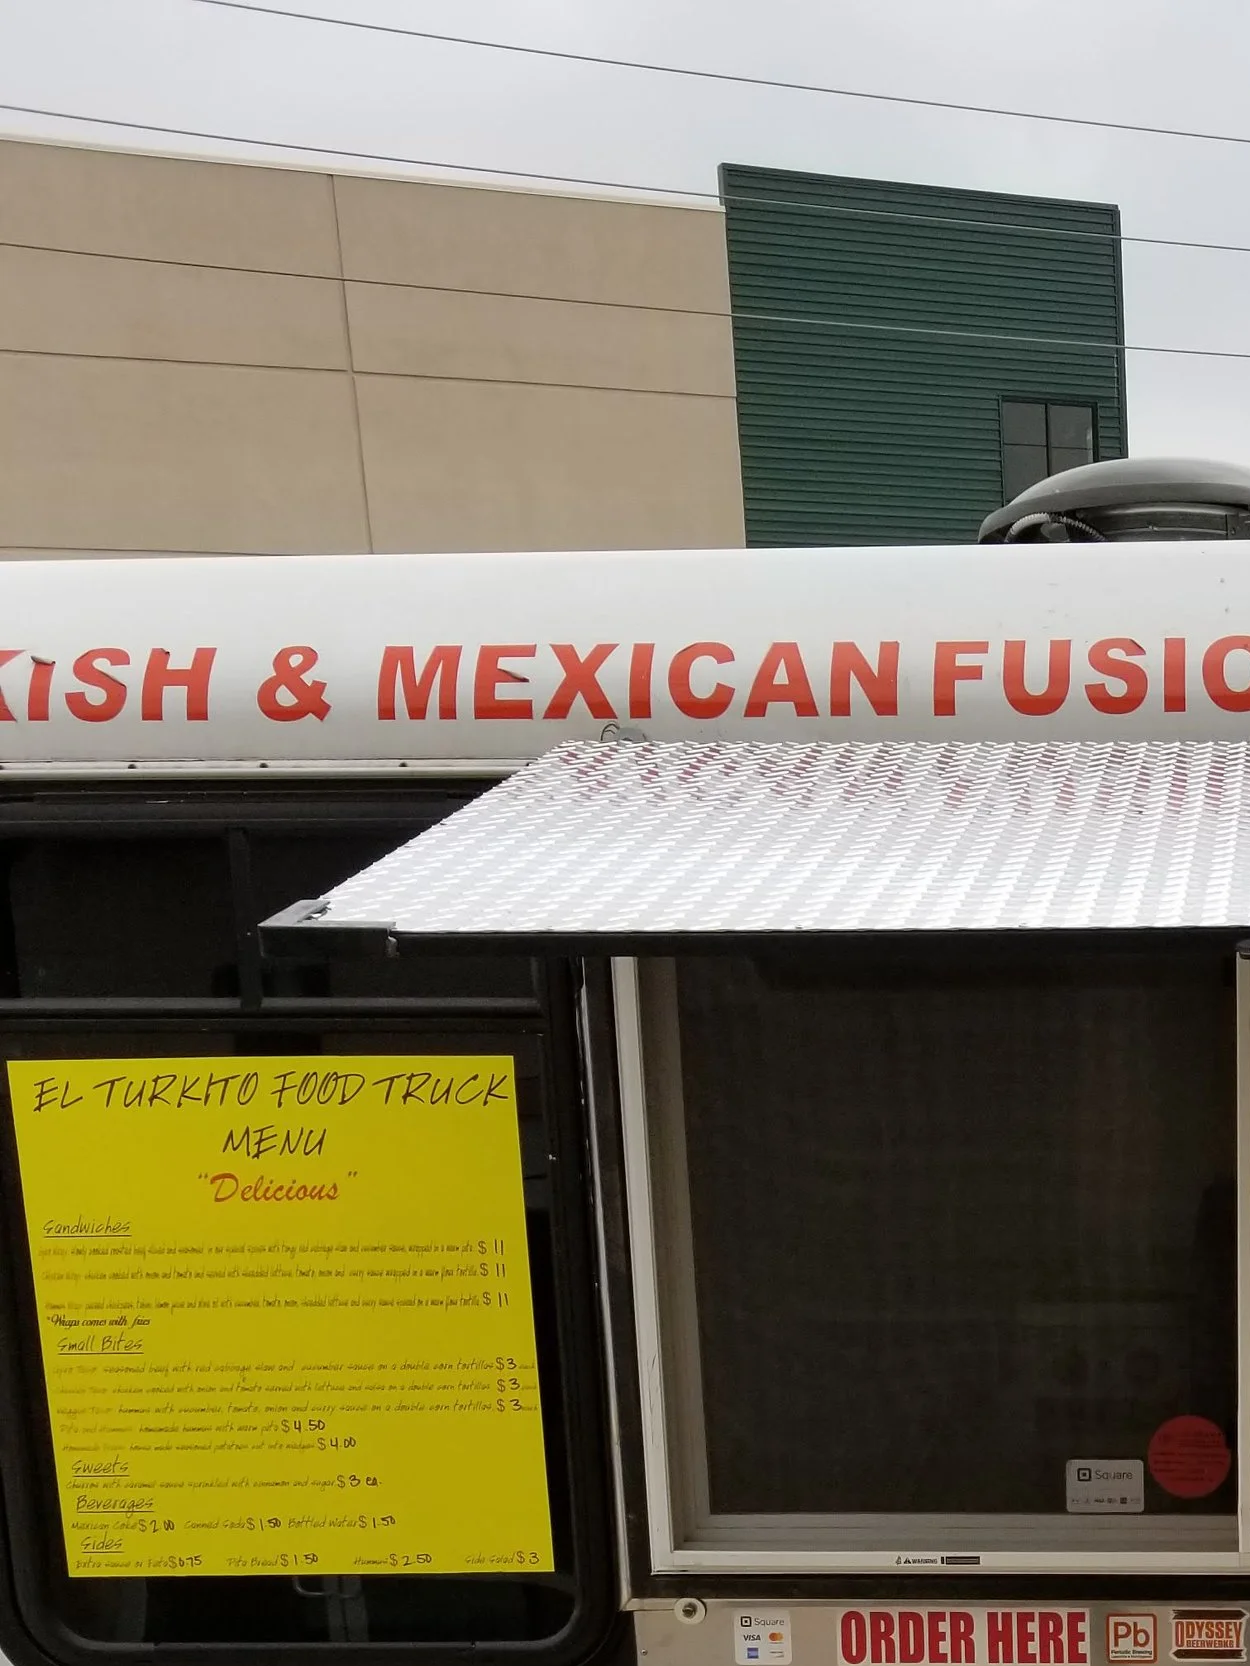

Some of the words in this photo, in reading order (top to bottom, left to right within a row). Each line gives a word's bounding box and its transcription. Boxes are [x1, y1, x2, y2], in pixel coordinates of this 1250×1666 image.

[257, 643, 332, 723] &
[377, 640, 901, 723] MEXICAN
[33, 1075, 83, 1112] EL
[93, 1070, 260, 1109] TURKITO
[270, 1070, 366, 1109] FOOD
[372, 1071, 509, 1106] TRUCK
[221, 1124, 328, 1160] MENU
[43, 1215, 132, 1237] Sandwiches
[81, 1318, 107, 1327] comes
[108, 1315, 128, 1327] with
[57, 1334, 95, 1352] Small
[101, 1331, 144, 1352] Bites
[72, 1453, 129, 1476] Sweets
[1094, 1470, 1134, 1483] Square
[77, 1494, 155, 1519] Beverages
[80, 1530, 124, 1553] Sides
[753, 1616, 786, 1628] Square
[743, 1633, 762, 1642] VISA
[840, 1610, 976, 1665] ORDER
[986, 1611, 1088, 1665] HERE
[1113, 1621, 1151, 1648] Pb
[1174, 1620, 1243, 1648] ODYSSEY
